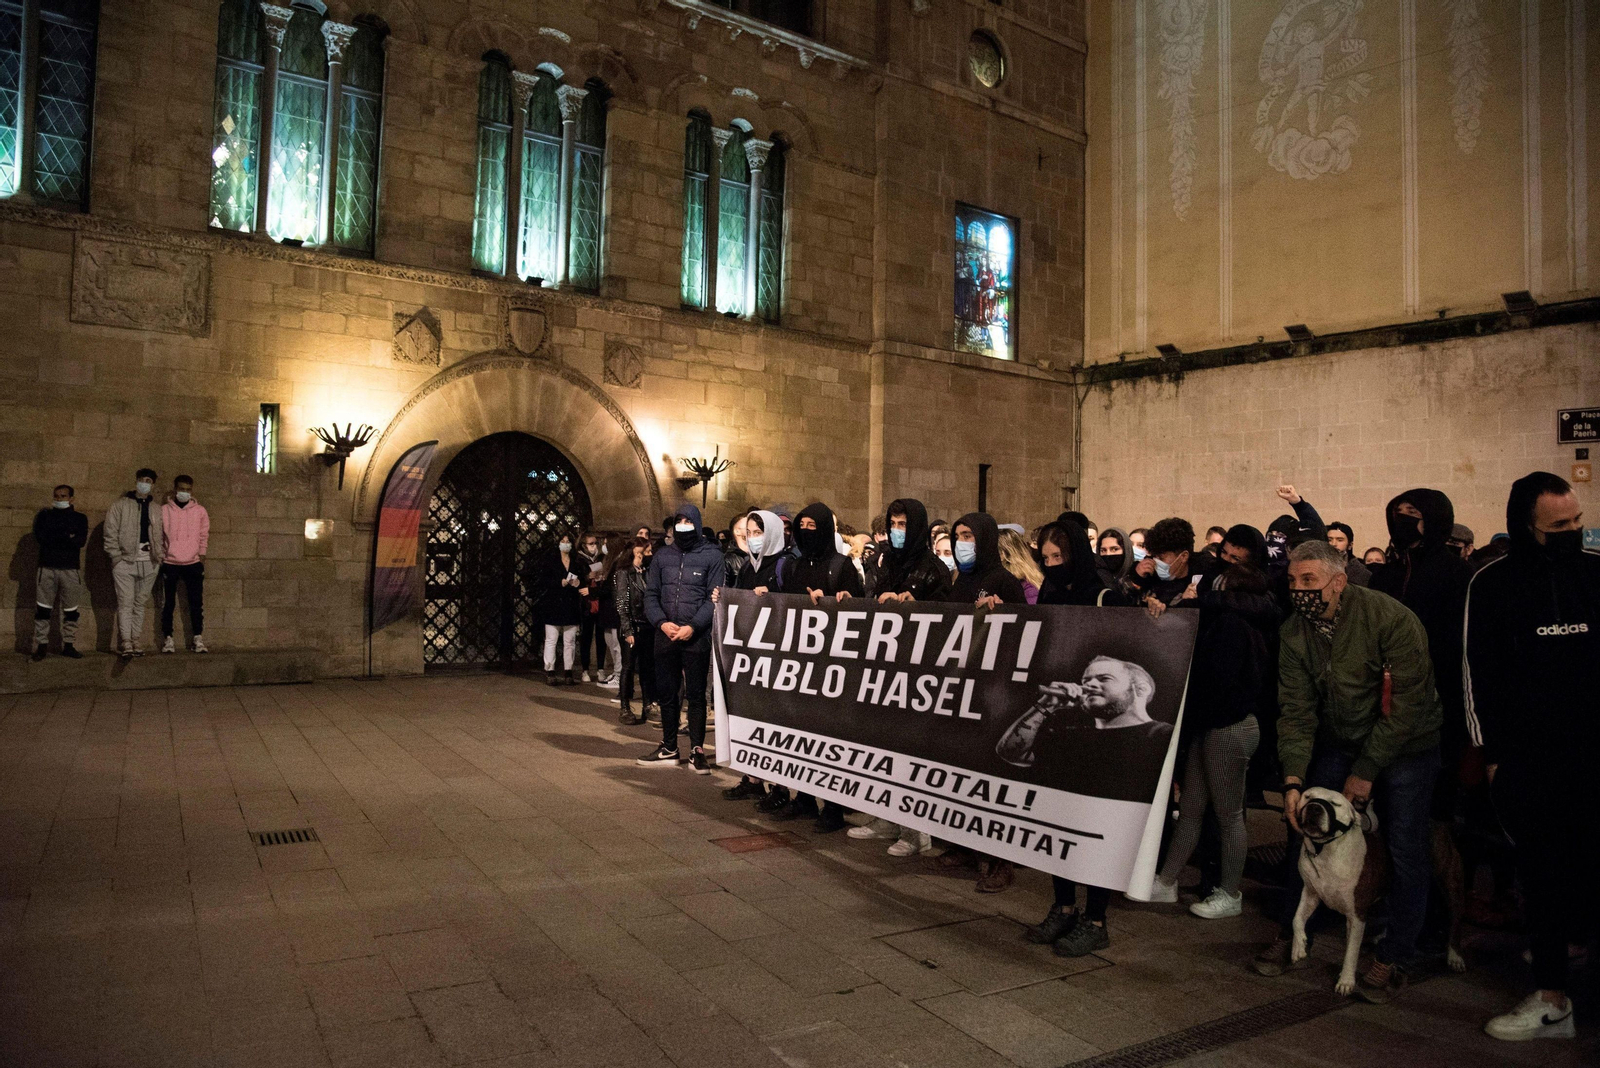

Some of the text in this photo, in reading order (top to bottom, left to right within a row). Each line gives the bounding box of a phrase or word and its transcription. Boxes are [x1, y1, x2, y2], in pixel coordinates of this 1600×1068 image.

[1584, 422, 1591, 430] la
[723, 604, 1042, 682] LLIBERTAT!
[1536, 623, 1589, 635] adidas
[729, 653, 982, 720] PABLO HASEL
[749, 726, 1037, 811] AMNISTIA TOTAL!
[736, 749, 1078, 861] ORGANITZEM LA SOLIDARITAT
